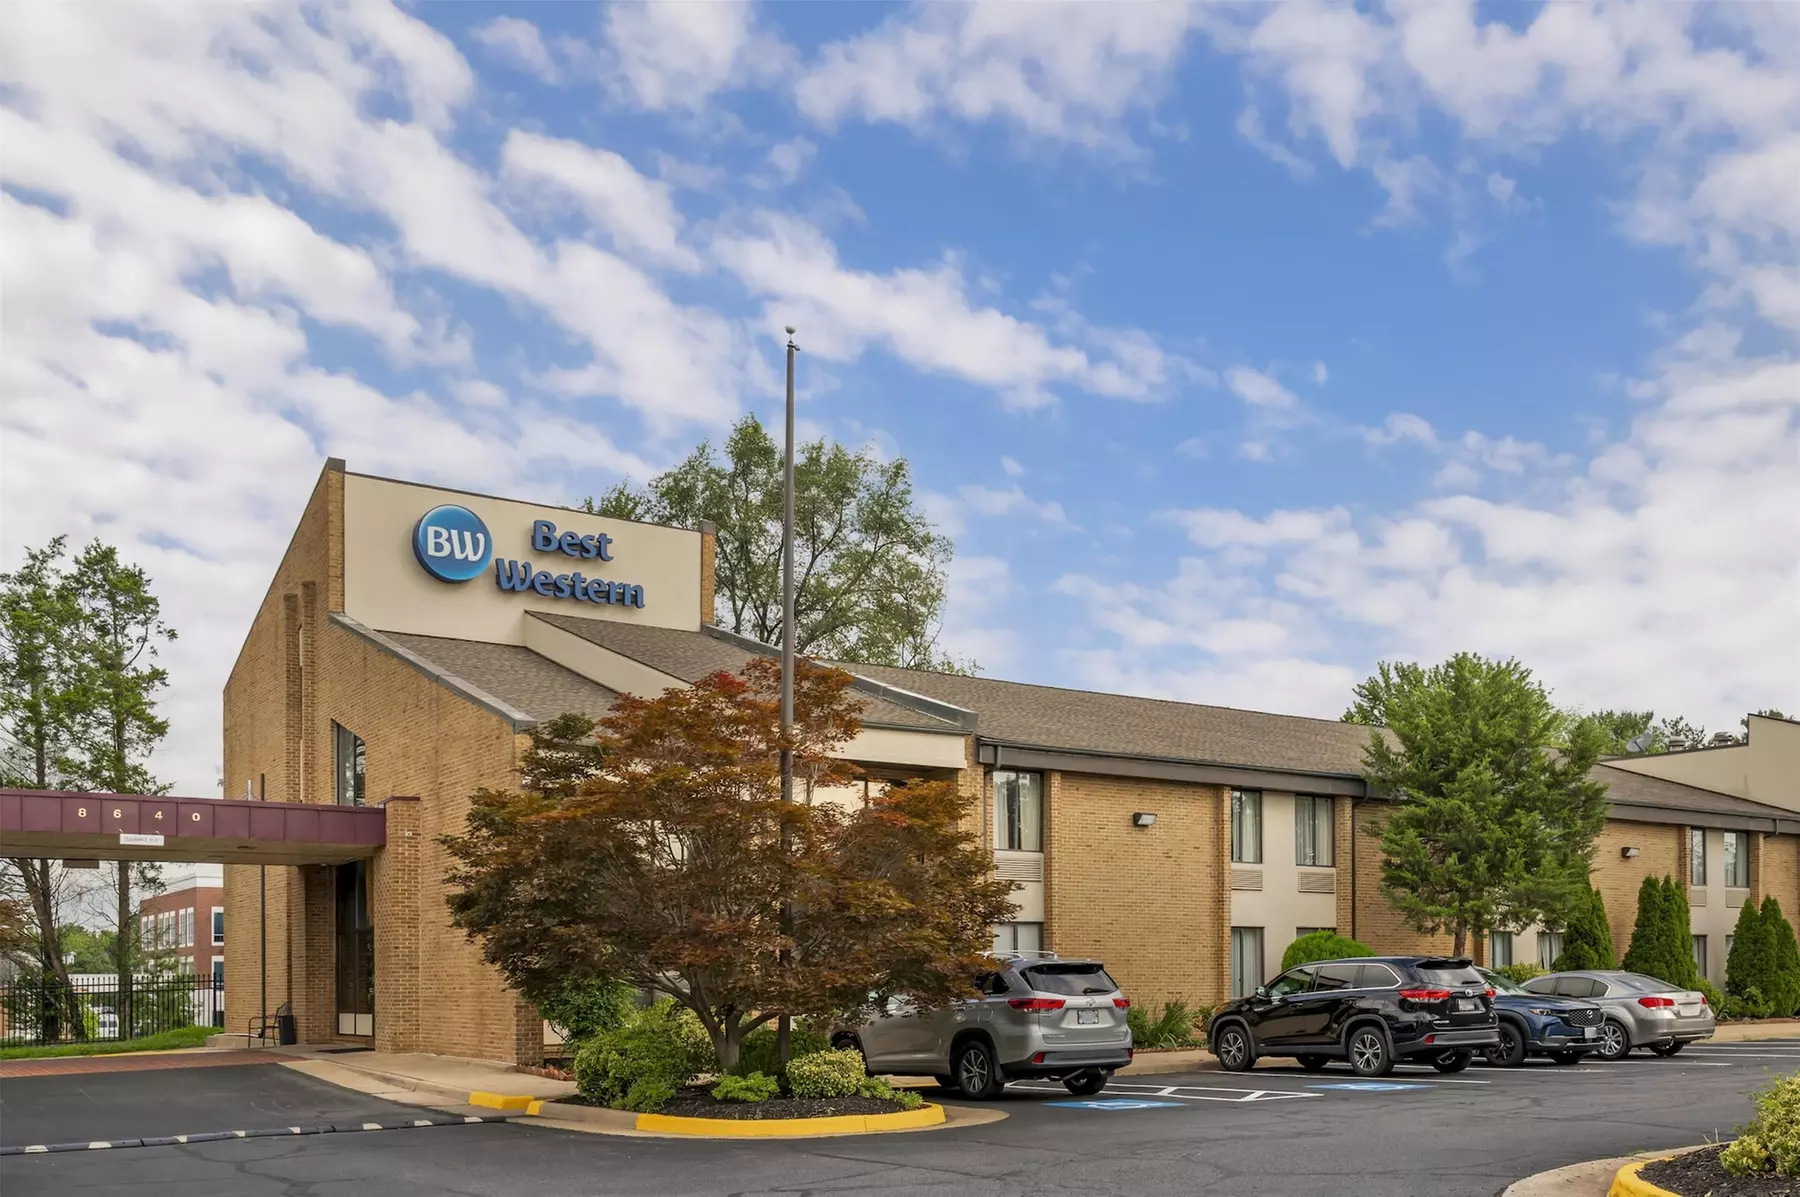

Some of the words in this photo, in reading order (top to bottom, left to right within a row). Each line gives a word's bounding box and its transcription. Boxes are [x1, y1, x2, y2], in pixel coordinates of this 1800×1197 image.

[426, 526, 486, 563] BW
[531, 519, 614, 562] Best
[495, 558, 646, 609] Western
